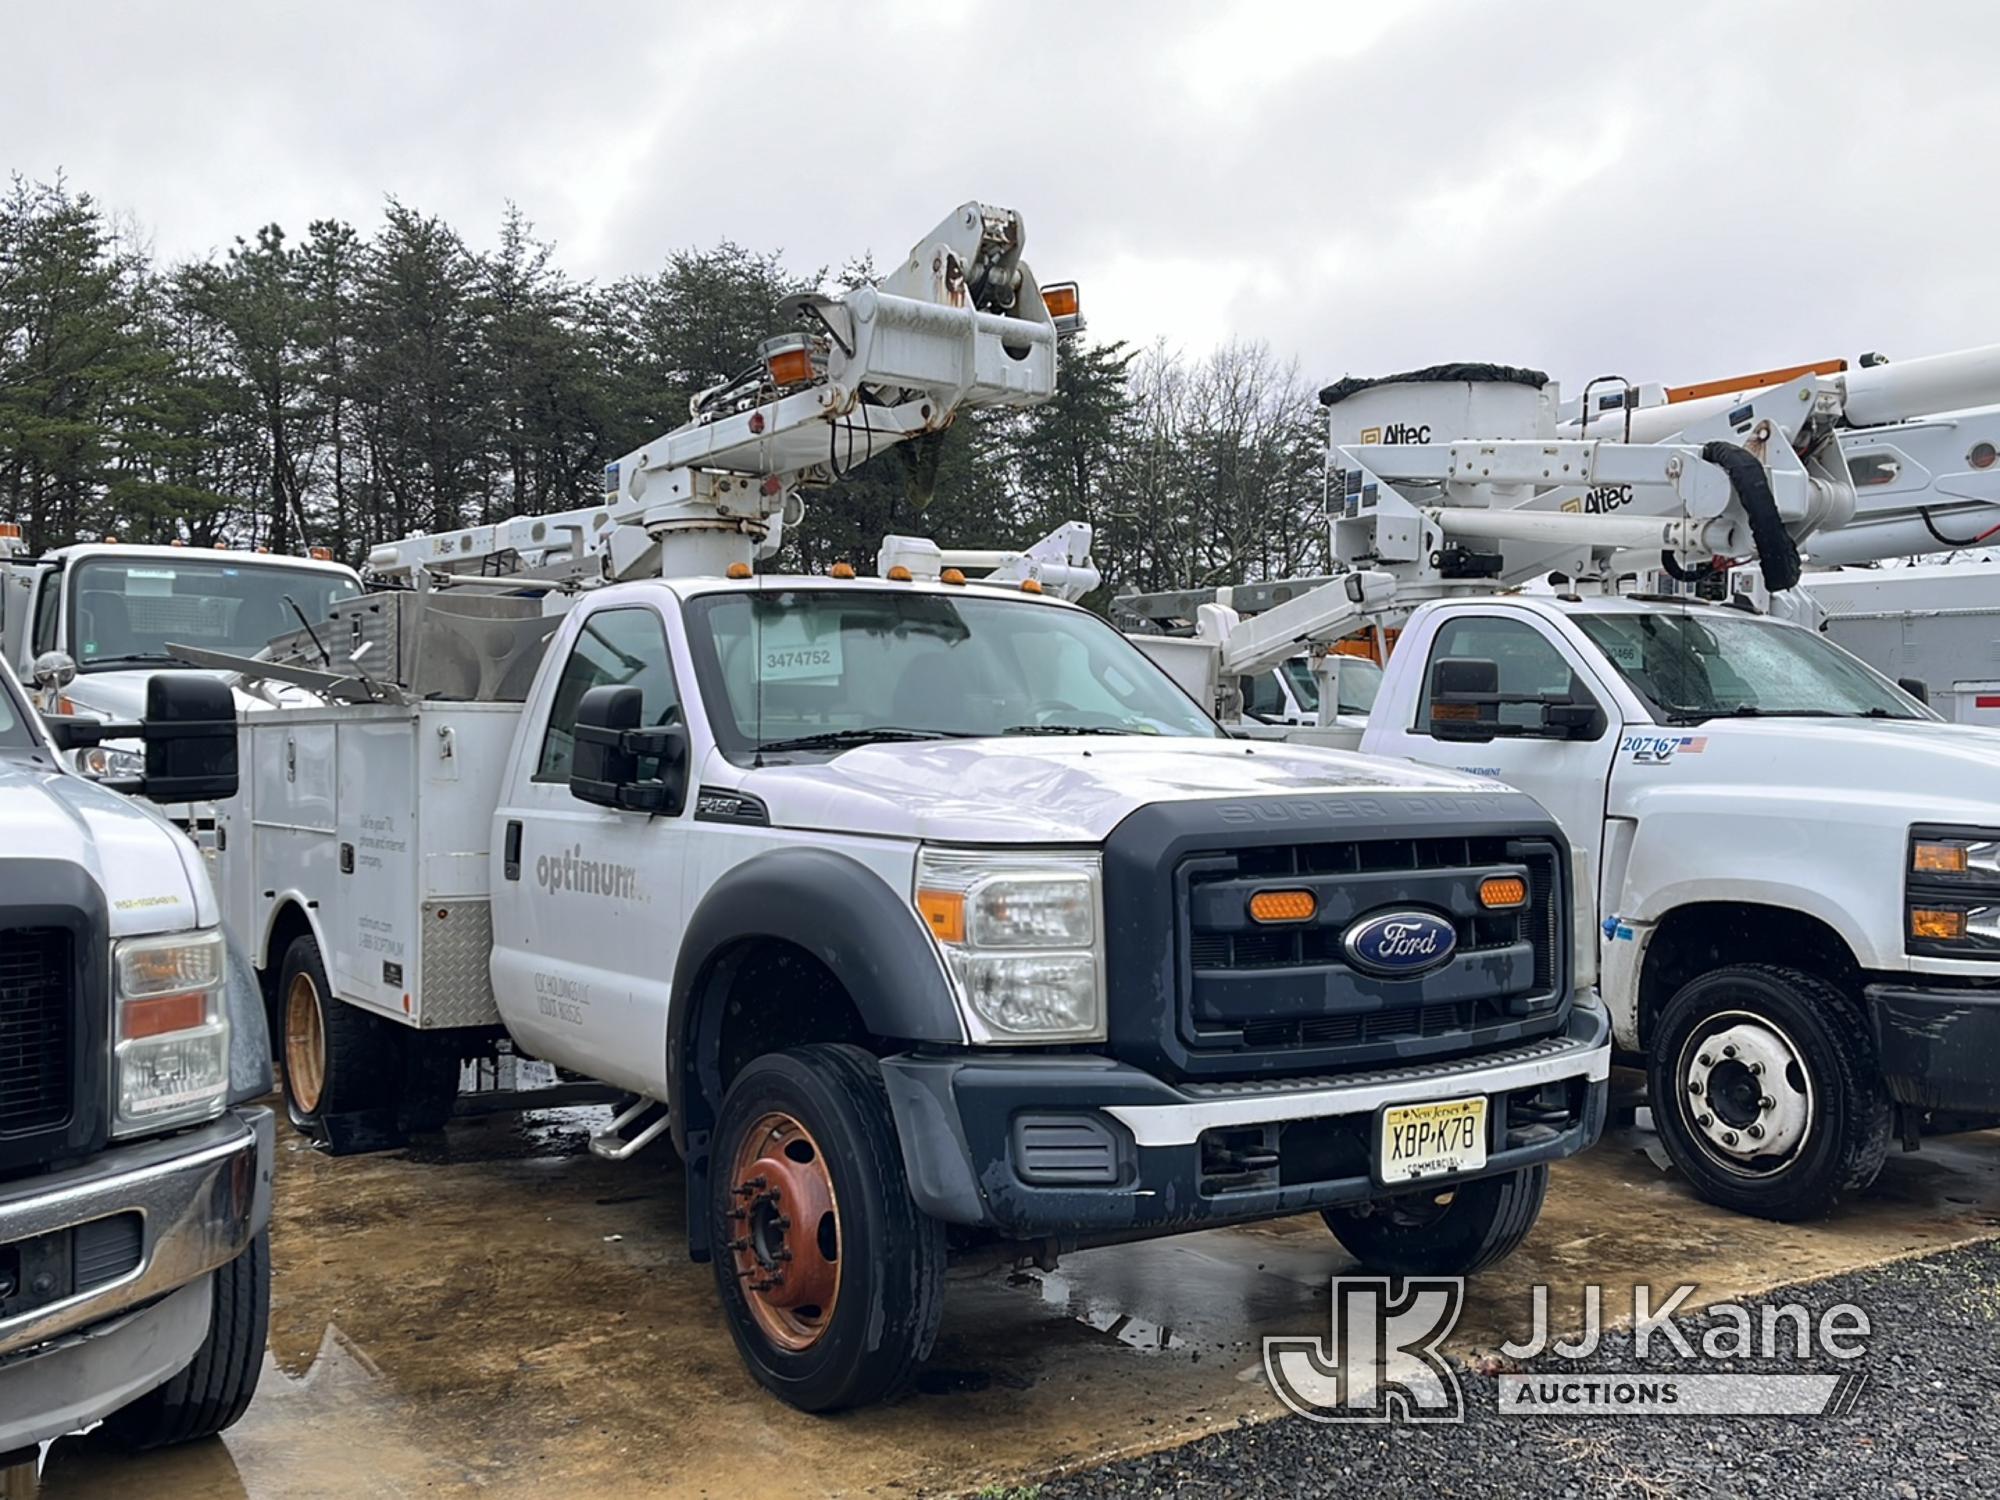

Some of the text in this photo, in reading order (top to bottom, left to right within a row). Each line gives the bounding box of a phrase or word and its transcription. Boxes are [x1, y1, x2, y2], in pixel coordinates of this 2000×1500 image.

[1383, 422, 1431, 445] Altec
[1584, 484, 1633, 514] Altec
[767, 650, 831, 668] 3474752
[1621, 736, 1680, 752] 207167
[1216, 797, 1506, 825] SUPER DUTY
[1378, 923, 1437, 957] Ford
[1432, 1105, 1460, 1120] Jersey
